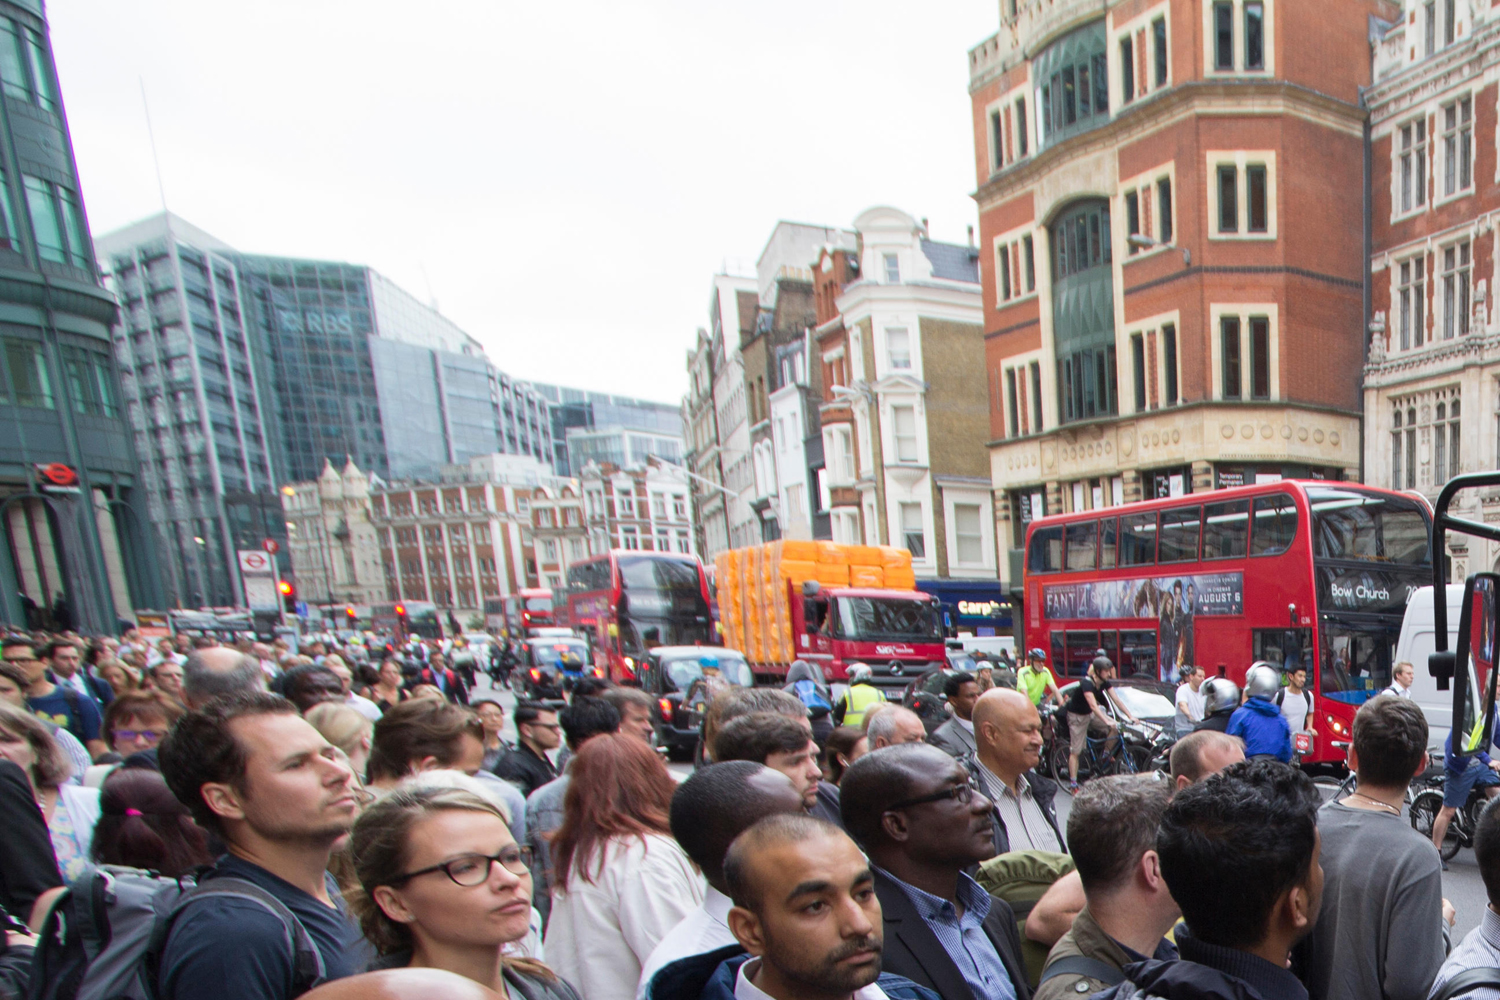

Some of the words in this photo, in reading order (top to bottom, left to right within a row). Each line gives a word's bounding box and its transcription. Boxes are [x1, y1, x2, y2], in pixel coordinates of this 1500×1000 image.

[1219, 472, 1243, 480] Temporary
[1199, 593, 1232, 603] AUGUST
[1234, 592, 1241, 602] 6
[1331, 583, 1352, 598] Bow
[1356, 585, 1390, 601] Church
